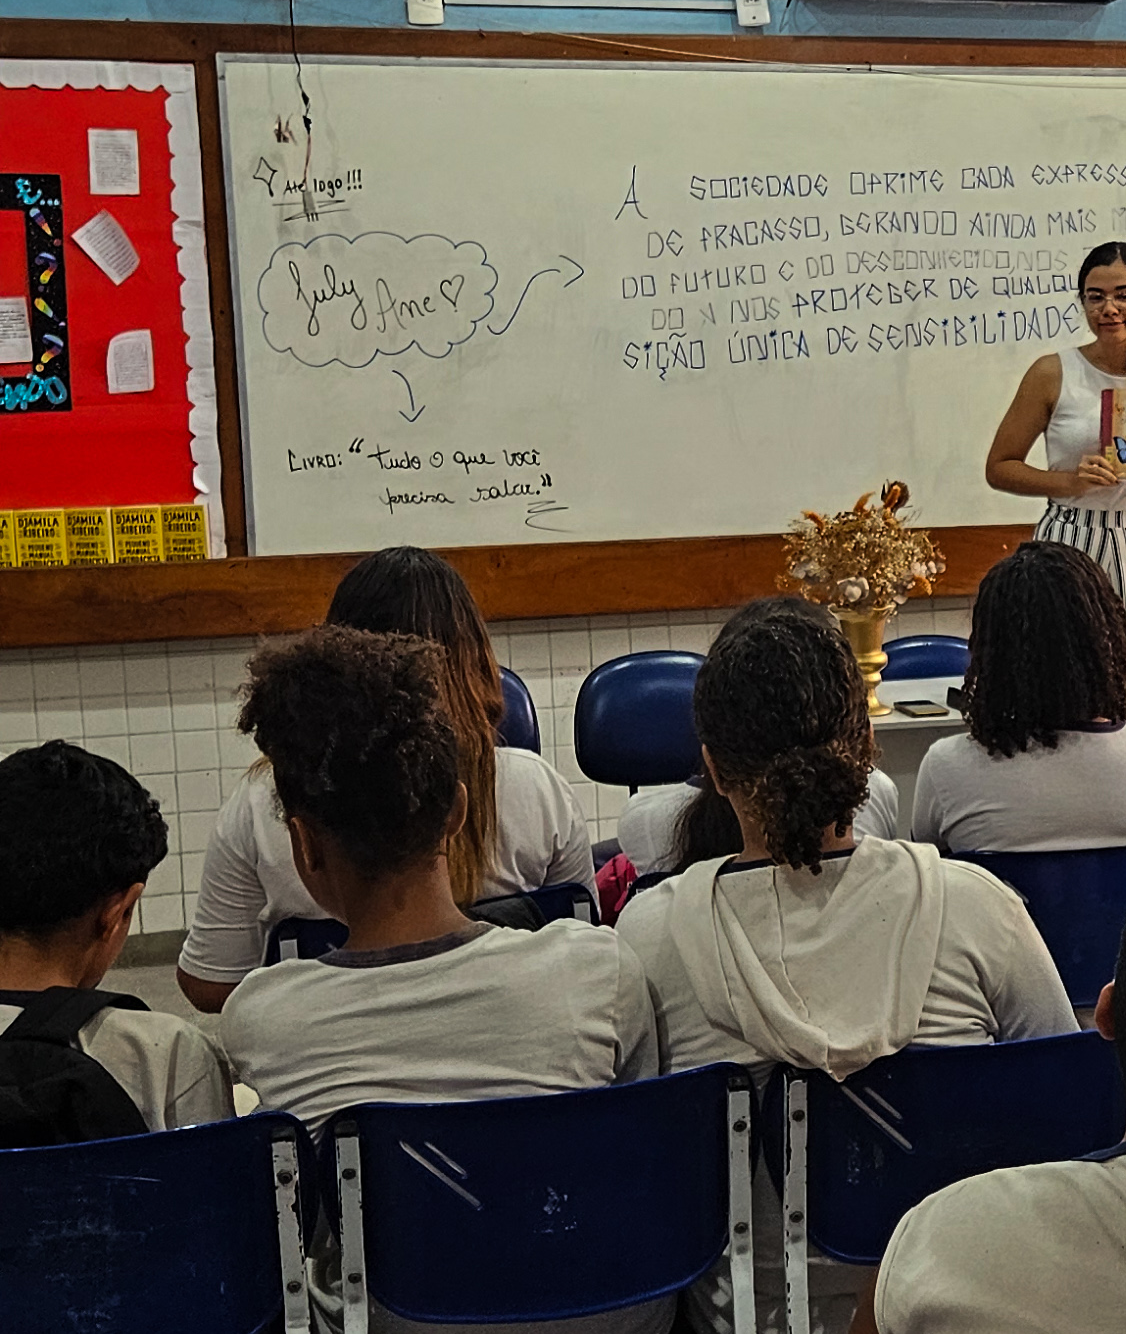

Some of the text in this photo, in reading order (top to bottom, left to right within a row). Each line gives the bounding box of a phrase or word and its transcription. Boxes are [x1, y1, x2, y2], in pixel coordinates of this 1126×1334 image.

[615, 164, 648, 220] A
[961, 166, 1015, 189] CADA
[647, 229, 683, 258] DE
[839, 210, 957, 236] GERANDO
[622, 275, 656, 299] DO
[778, 260, 794, 281] E
[806, 254, 834, 279] DO
[652, 307, 684, 330] DO
[731, 296, 780, 324] NOS
[792, 278, 938, 318] PROTEGER
[950, 277, 979, 300] DE
[992, 274, 1079, 299] QUALQU
[827, 325, 858, 355] DE
